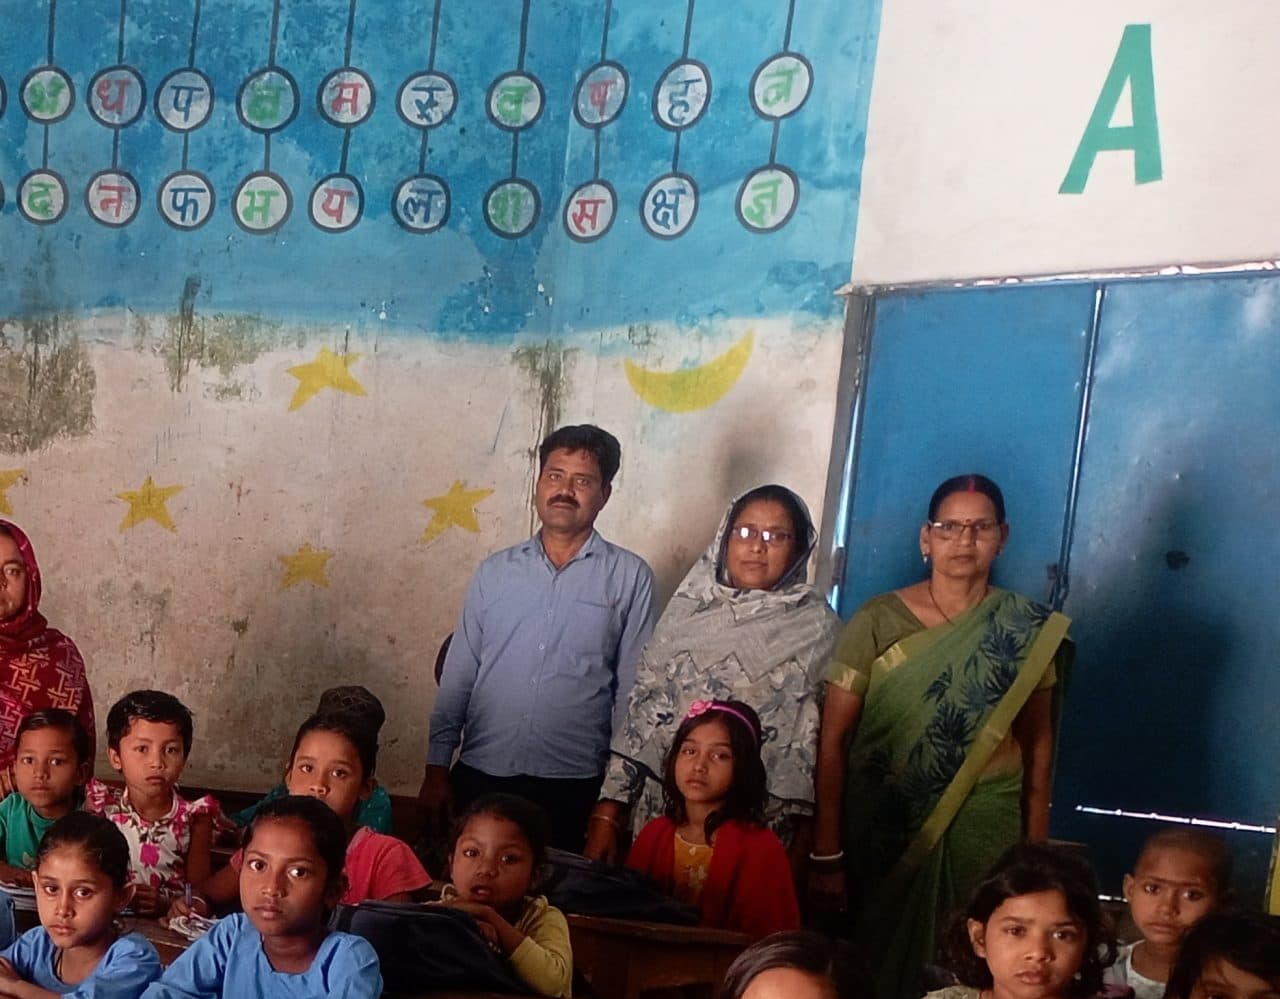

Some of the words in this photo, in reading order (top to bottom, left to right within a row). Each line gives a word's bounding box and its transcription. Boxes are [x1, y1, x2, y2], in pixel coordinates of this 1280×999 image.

[169, 84, 204, 123] प
[331, 82, 365, 116] म
[667, 78, 702, 124] ह
[1058, 24, 1163, 194] A
[97, 184, 130, 218] न
[169, 187, 207, 222] फ
[242, 188, 280, 224] भ
[321, 187, 354, 224] य
[571, 198, 606, 234] स
